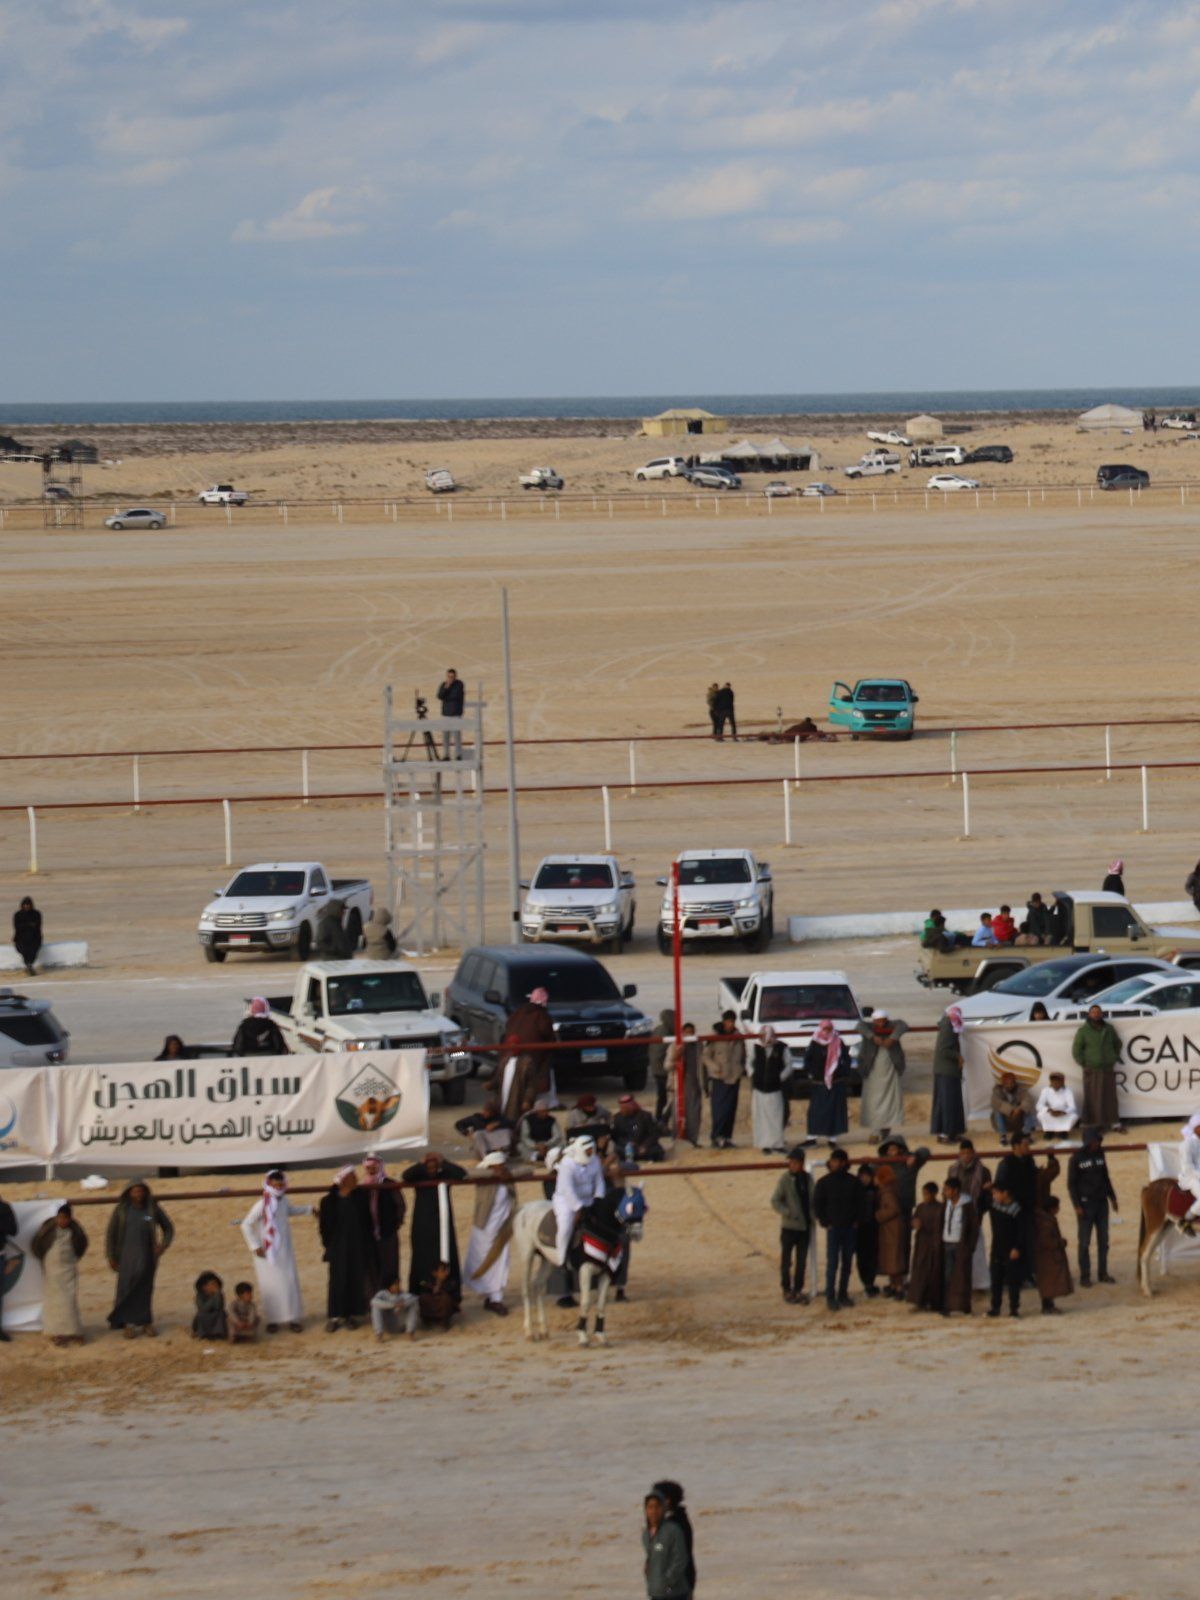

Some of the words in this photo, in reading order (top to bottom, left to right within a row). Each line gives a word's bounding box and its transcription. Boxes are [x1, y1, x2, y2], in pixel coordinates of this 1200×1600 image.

[95, 1068, 196, 1109] الهجن
[207, 1067, 301, 1105] سباق
[79, 1114, 175, 1146] بالعريش
[180, 1116, 251, 1144] الهجن
[257, 1115, 316, 1142] سباق
